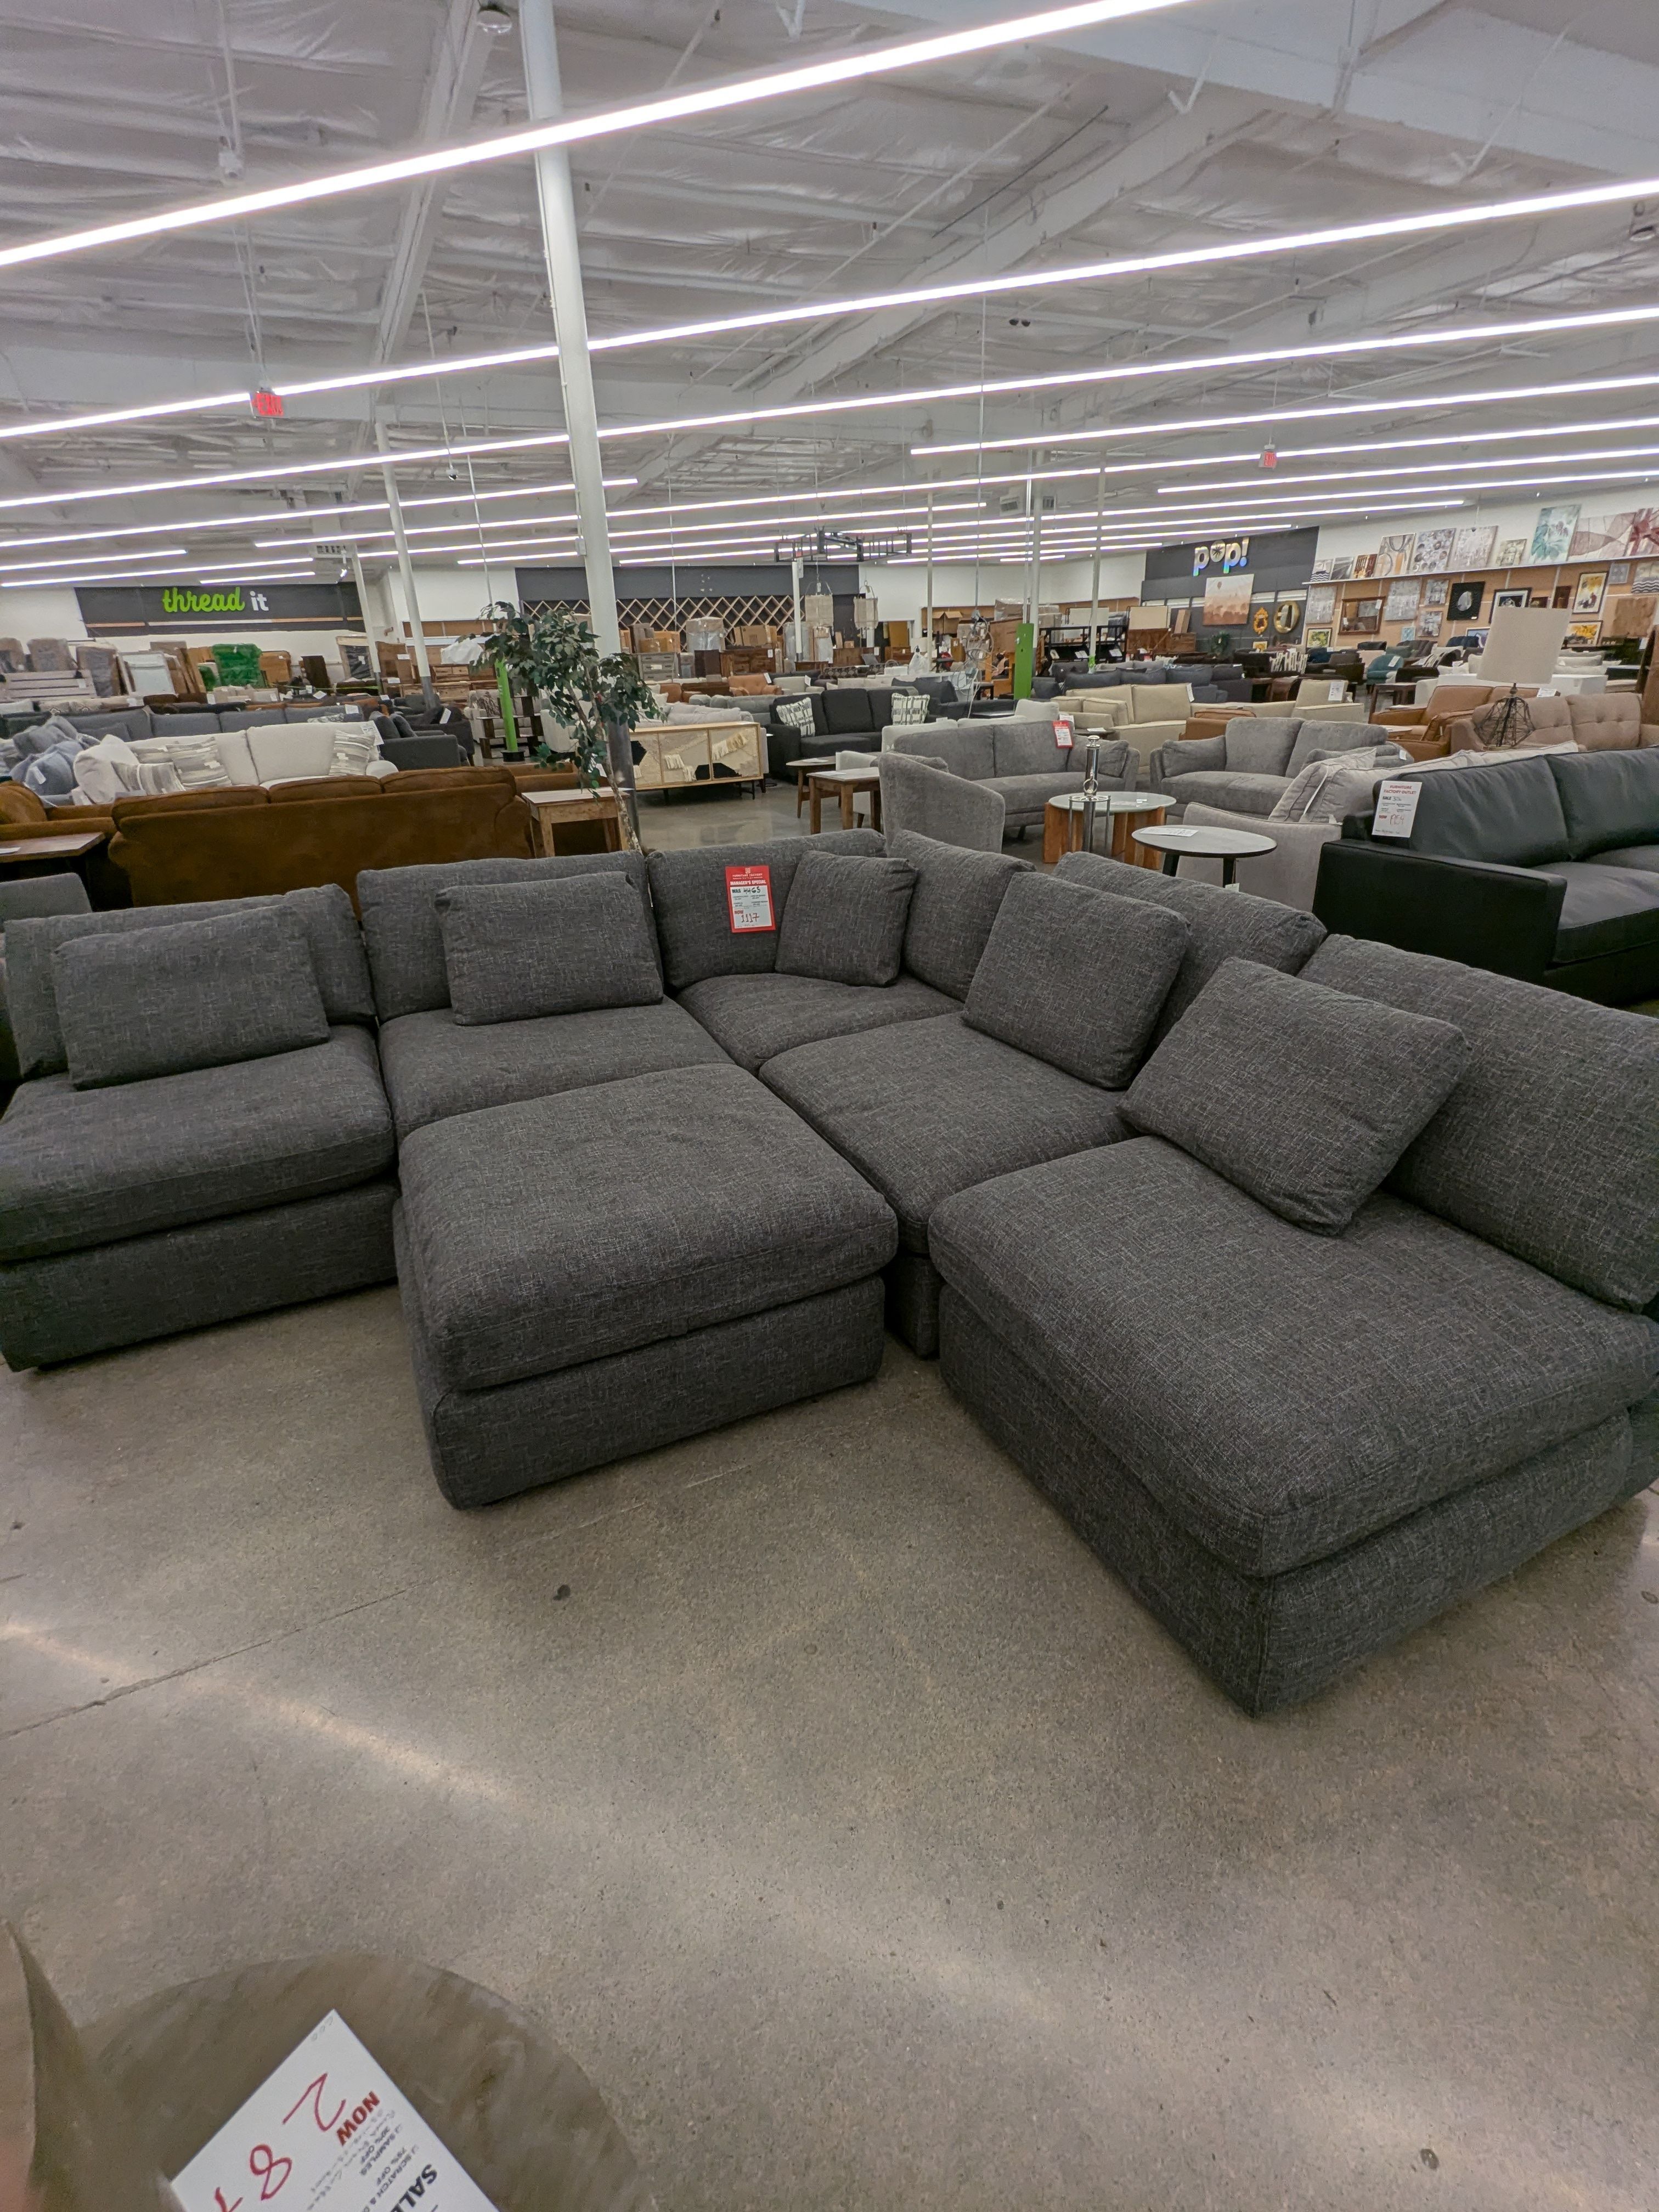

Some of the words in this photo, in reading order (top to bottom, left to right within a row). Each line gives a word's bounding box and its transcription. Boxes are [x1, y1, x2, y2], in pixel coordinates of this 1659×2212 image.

[1193, 537, 1249, 576] pop!
[162, 587, 245, 612] thread
[250, 590, 269, 611] it
[741, 913, 759, 923] 1117
[336, 2091, 380, 2146] NOW
[359, 2132, 396, 2176] SAMPLES
[360, 2145, 375, 2164] OFF
[376, 2166, 391, 2186] OFF
[377, 2153, 412, 2198] SCRATCH
